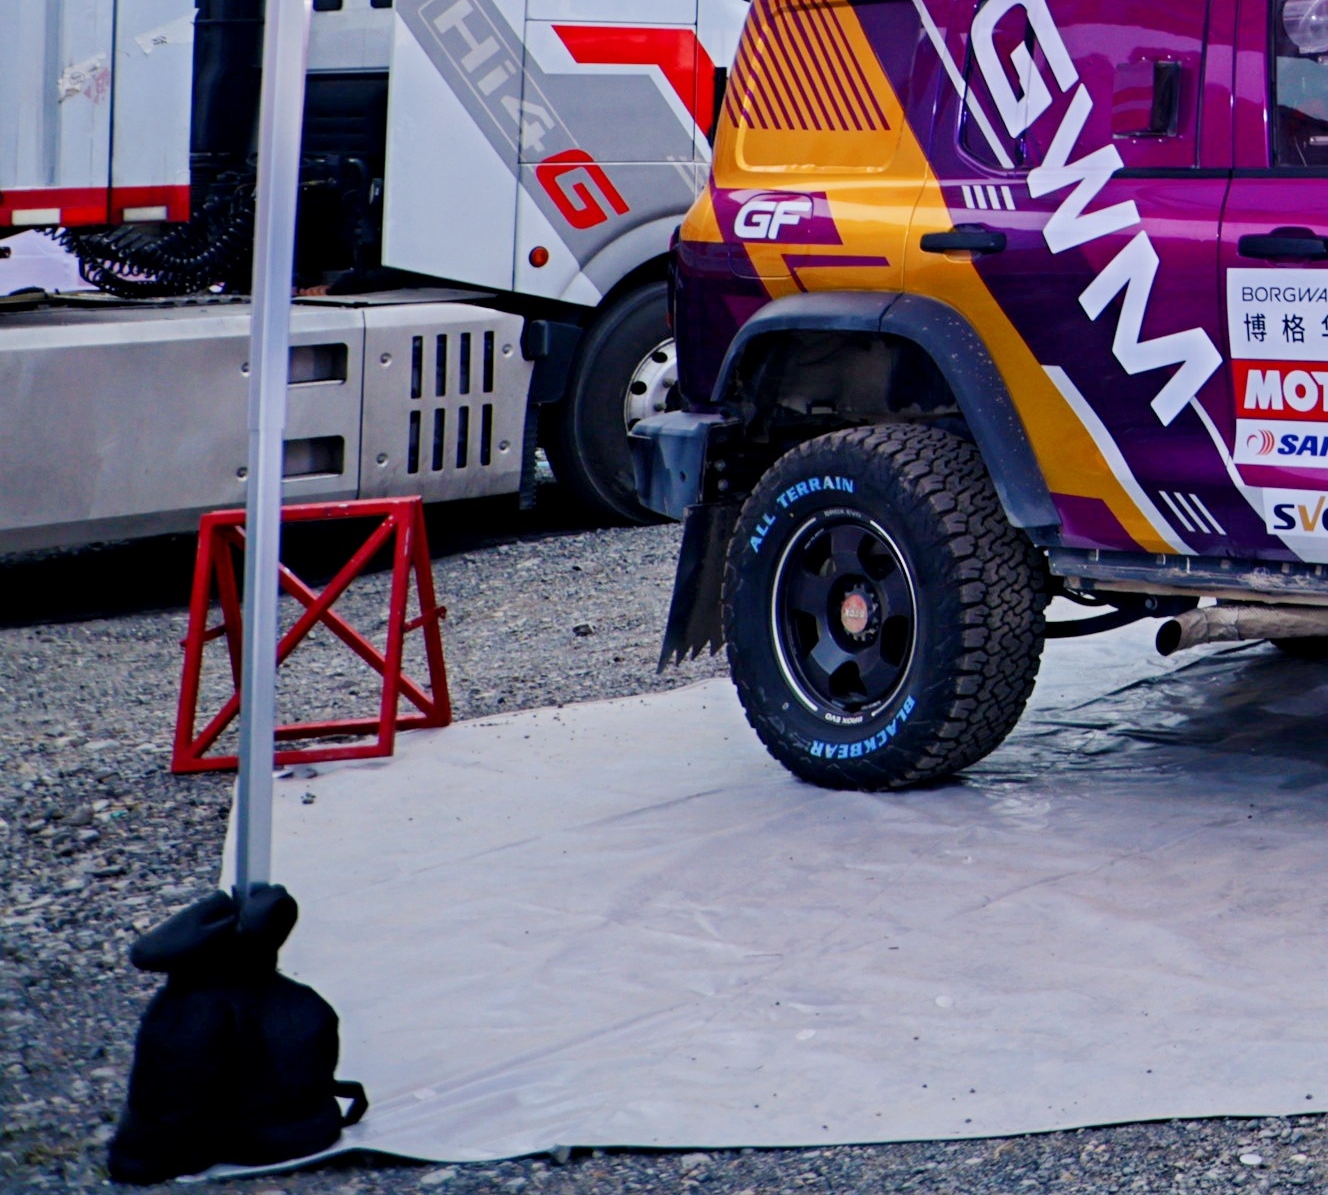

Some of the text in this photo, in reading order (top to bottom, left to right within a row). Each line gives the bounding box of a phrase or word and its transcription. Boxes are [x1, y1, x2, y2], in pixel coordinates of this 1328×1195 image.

[733, 200, 812, 240] GF
[750, 512, 776, 554] ALL
[776, 476, 855, 508] TERRAIN
[811, 695, 916, 759] BLACKBEAR
